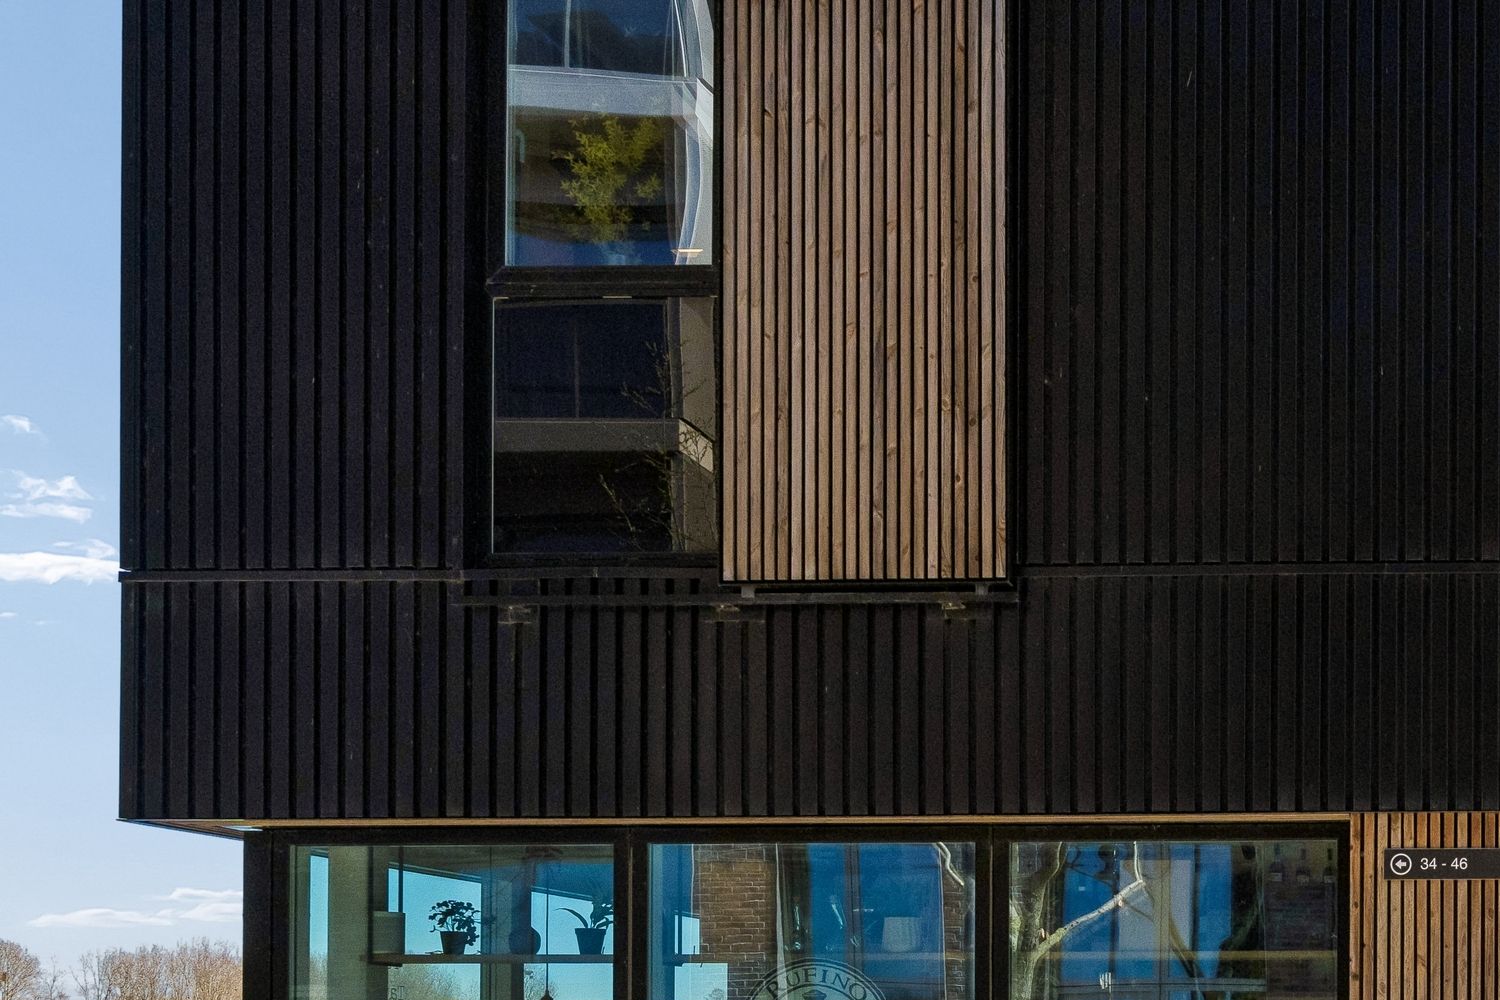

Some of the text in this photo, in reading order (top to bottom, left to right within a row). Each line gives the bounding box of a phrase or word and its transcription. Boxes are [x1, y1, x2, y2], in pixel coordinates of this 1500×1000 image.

[1420, 857, 1437, 870] 34
[1450, 857, 1468, 870] 46
[766, 967, 867, 1000] RUFINO
